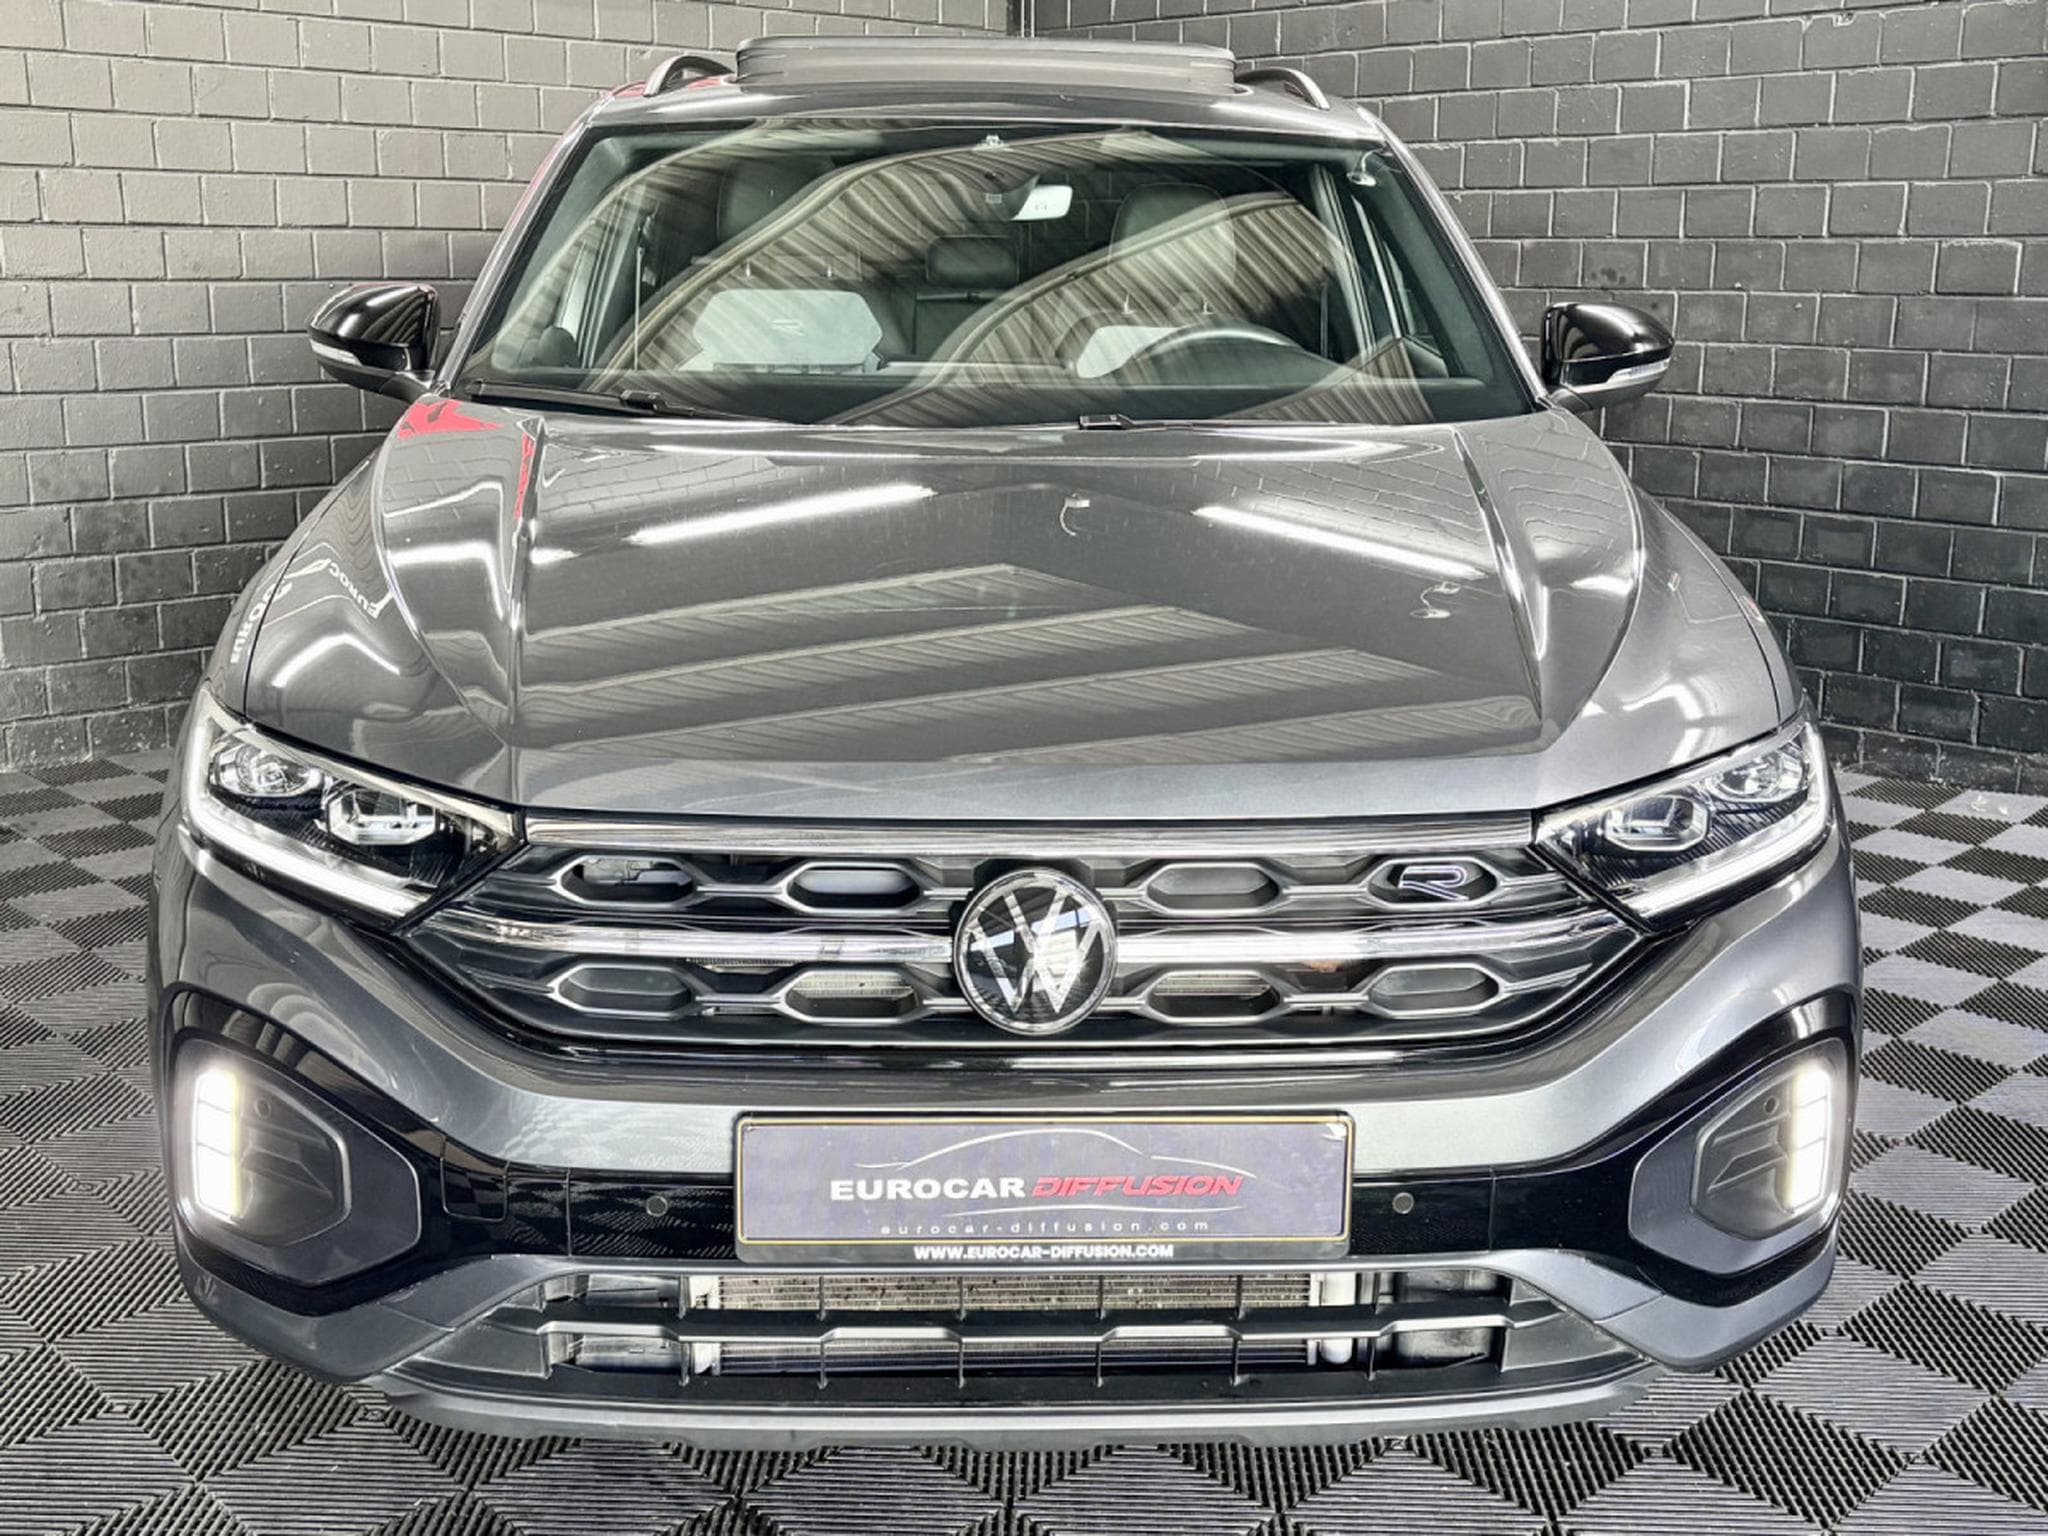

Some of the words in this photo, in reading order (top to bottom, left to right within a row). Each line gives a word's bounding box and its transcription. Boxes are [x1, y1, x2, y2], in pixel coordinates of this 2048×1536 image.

[1397, 864, 1470, 901] R
[830, 1177, 1026, 1201] EUROCAR
[1030, 1174, 1244, 1198] DIFFUSION
[880, 1221, 1209, 1236] eurocar-diffusion.com
[913, 1244, 1175, 1260] WWW.EUROCAR-DIFFUSION.COM
